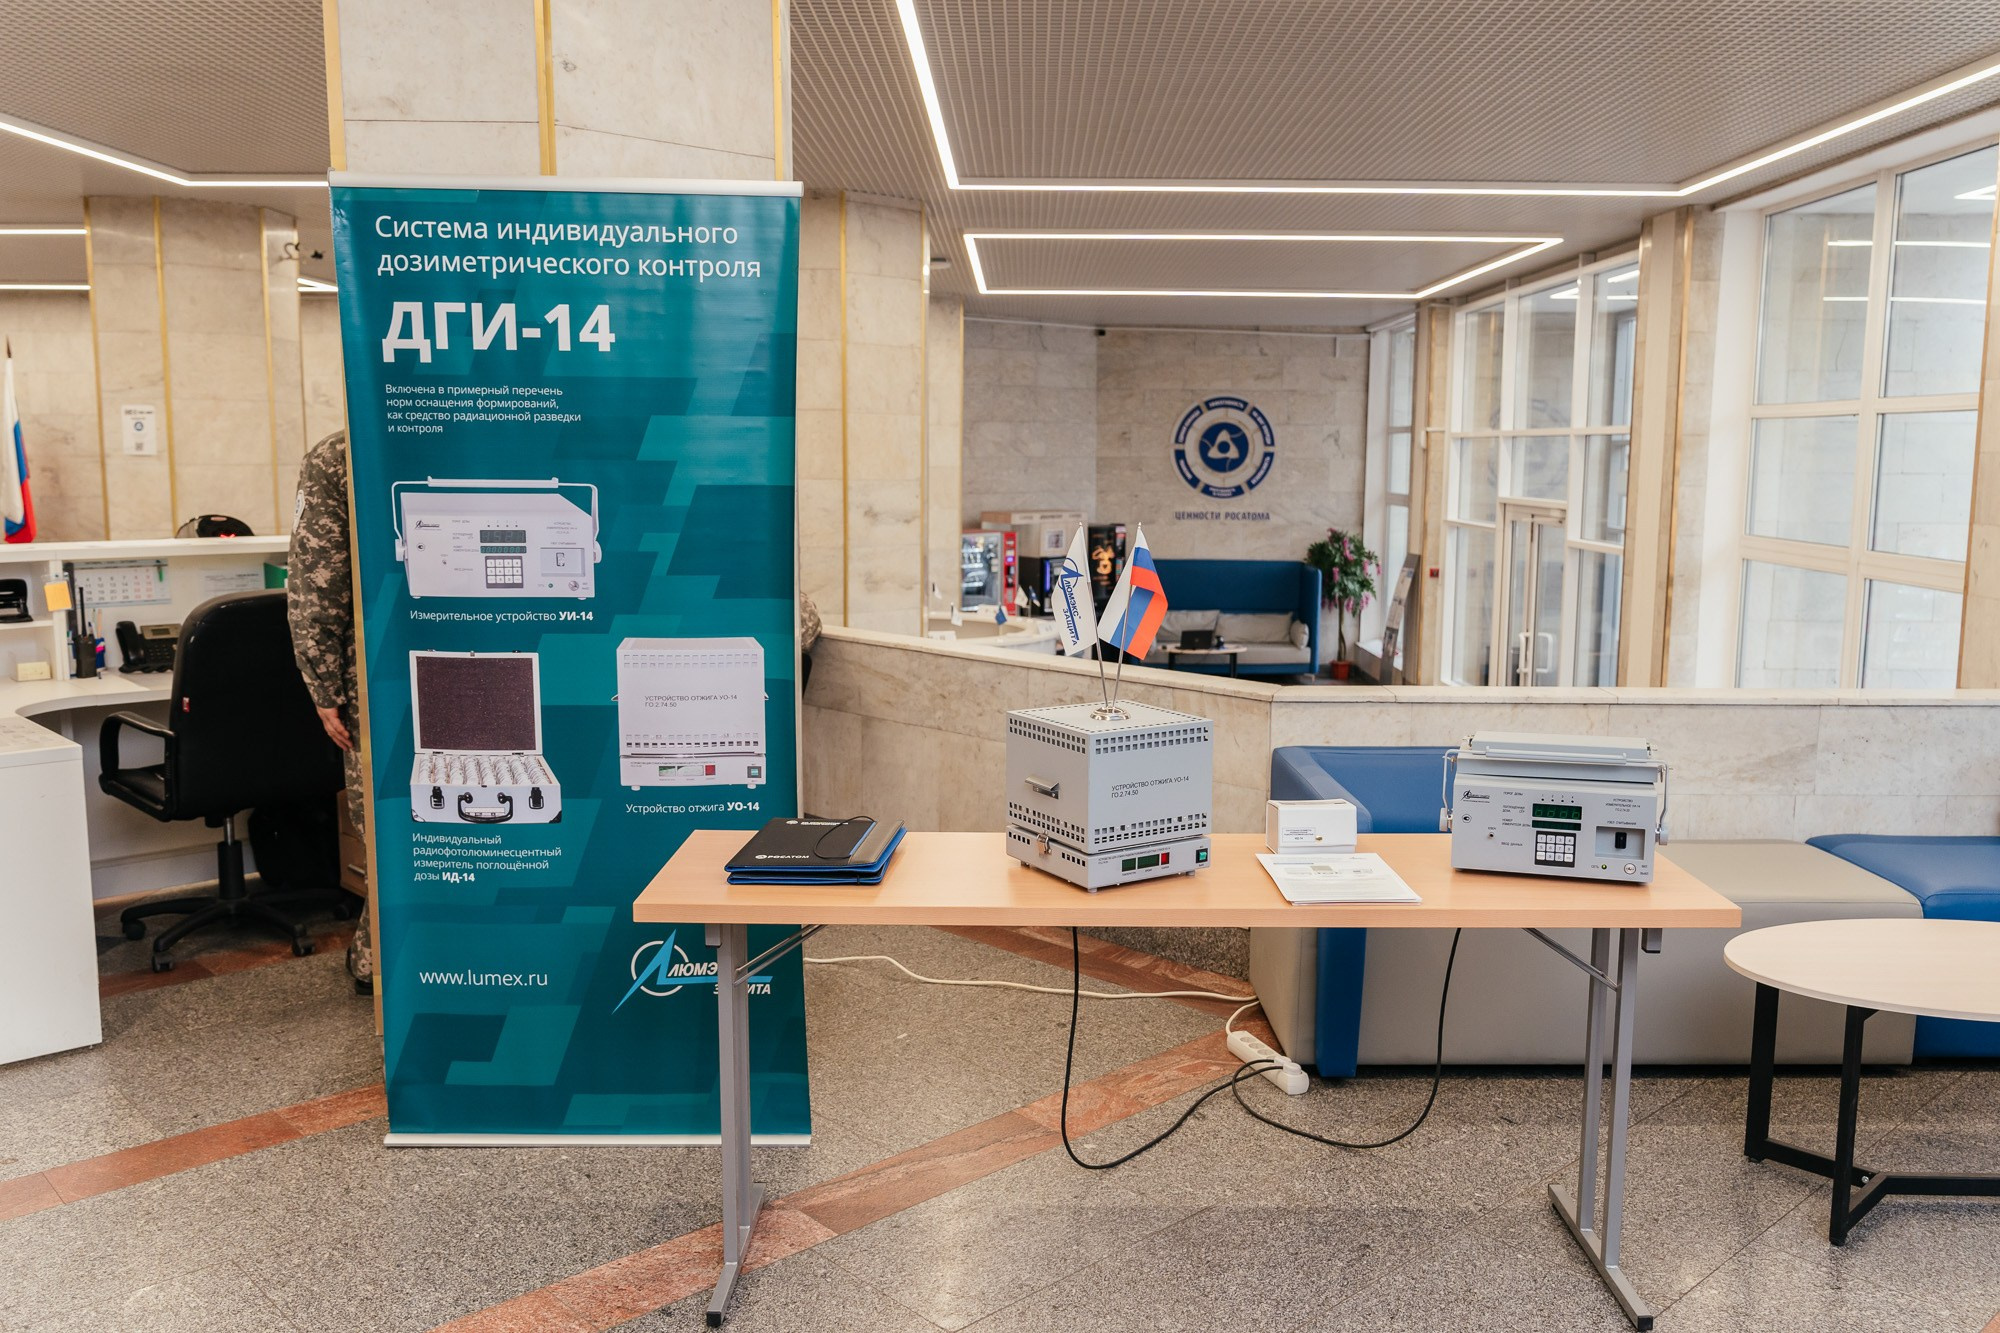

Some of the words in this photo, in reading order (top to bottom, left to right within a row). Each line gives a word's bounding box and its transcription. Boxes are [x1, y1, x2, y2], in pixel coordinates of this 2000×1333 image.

[376, 216, 487, 239] Система
[498, 223, 739, 248] индивидуального
[378, 255, 629, 279] дозиметрического
[639, 259, 760, 282] контроля
[382, 302, 615, 363] ДГИ-14
[385, 383, 436, 395] Включена
[438, 386, 445, 395] в
[447, 385, 510, 397] примерный
[511, 387, 563, 398] перечень
[386, 398, 413, 409] норм
[414, 399, 474, 409] оснащения
[476, 398, 559, 411] формирований,
[387, 411, 404, 420] как
[405, 411, 451, 422] средство
[453, 411, 531, 423] радиационной
[533, 413, 582, 424] разведки
[387, 425, 395, 433] и
[397, 424, 444, 435] контроля
[1175, 511, 1221, 521] ЦЕННОСТИ
[1225, 512, 1270, 521] РОСАТОМА
[1064, 579, 1079, 617] ЛЮМЭКС
[410, 610, 494, 623] Измерительное
[495, 610, 557, 624] устройство
[558, 611, 594, 621] УИ-14
[1062, 608, 1078, 646] ЗАЩИТА
[1112, 782, 1149, 791] УСТРОЙСТВО
[1150, 777, 1173, 787] ОТЖИГА
[625, 804, 686, 816] Устройство
[688, 804, 725, 813] отжига
[726, 802, 760, 812] УО-14
[412, 832, 502, 845] Индивидуальный
[412, 846, 562, 859] радиофотолюминесцентный
[413, 859, 474, 870] измеритель
[476, 859, 549, 872] поглощённой
[413, 872, 440, 882] дозы
[441, 871, 476, 883] ИД-14
[419, 969, 548, 987] www.lumex.ru
[713, 983, 771, 995] ЗИТА
